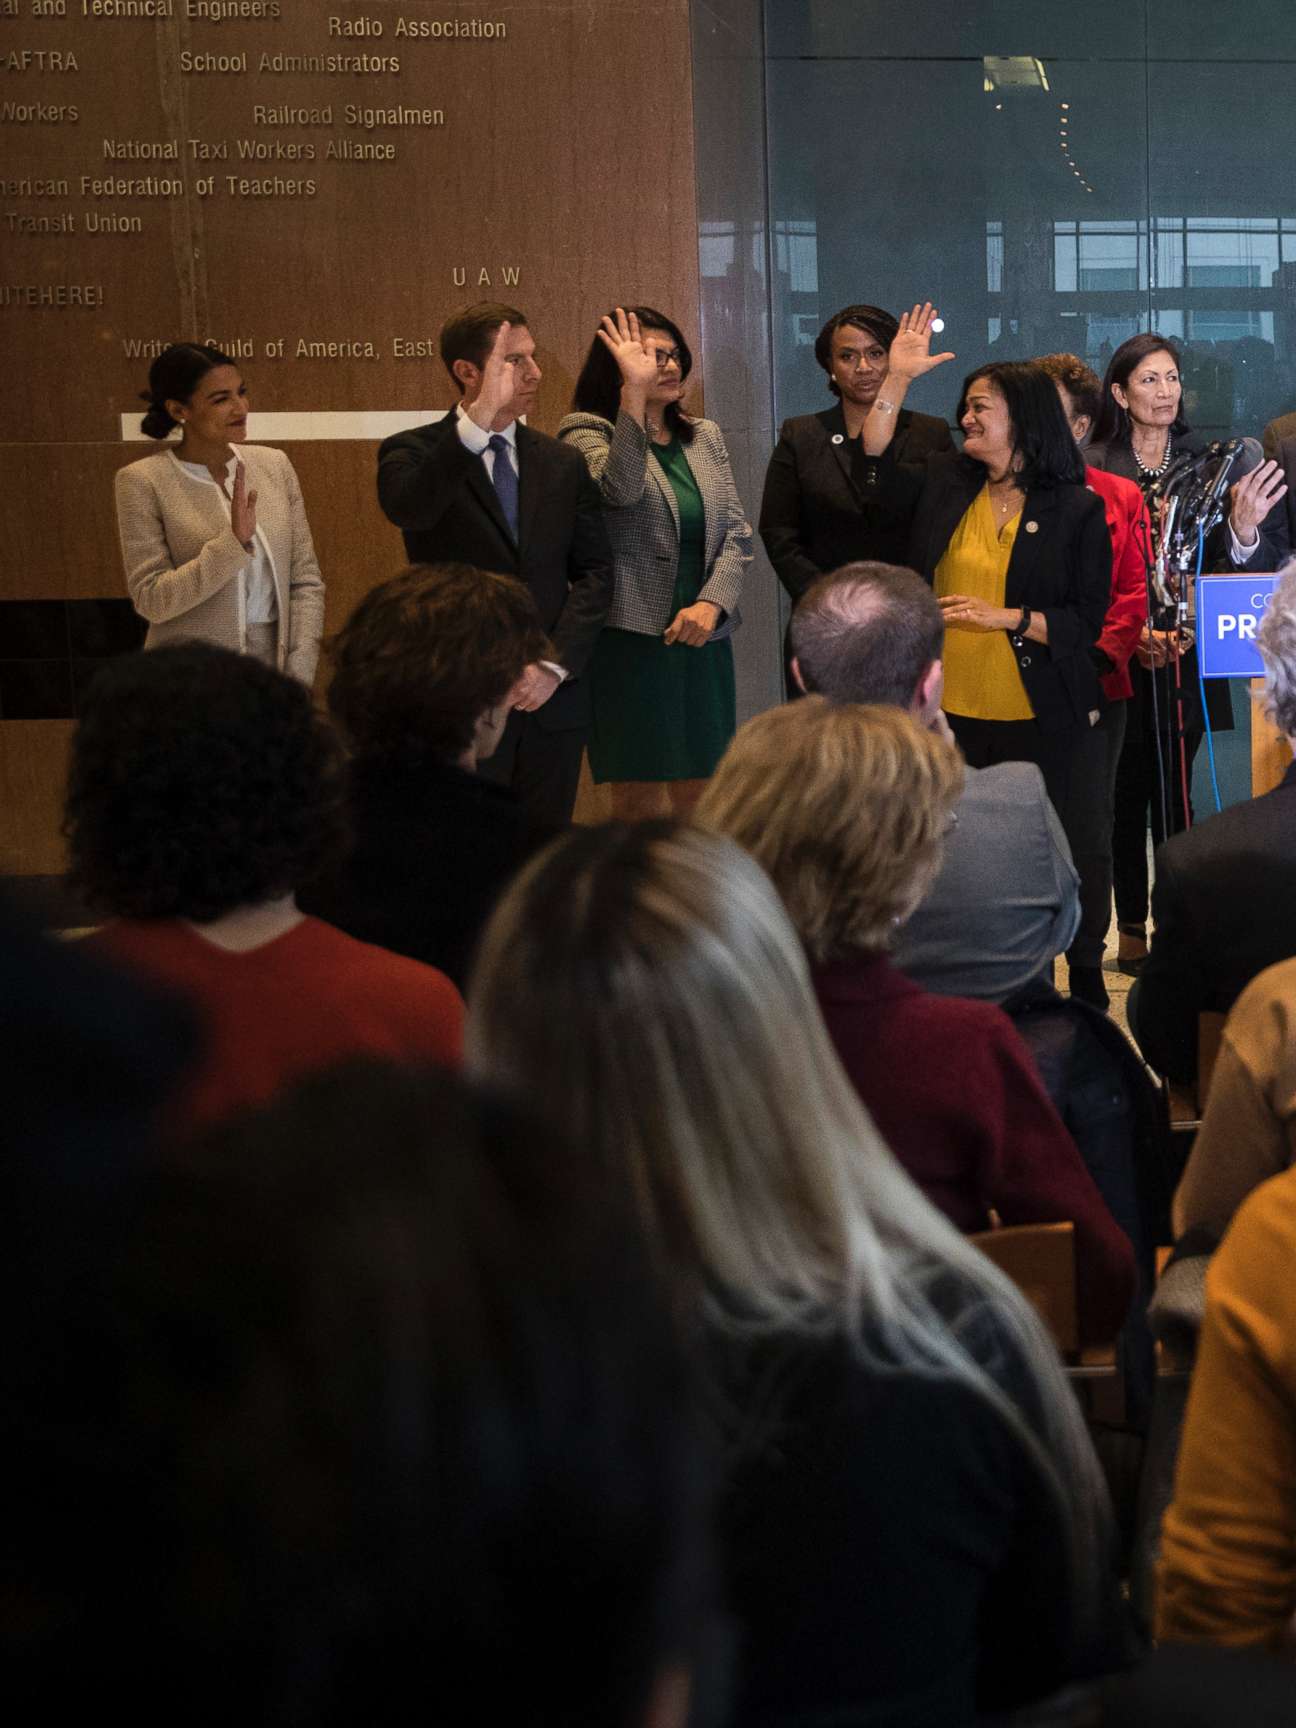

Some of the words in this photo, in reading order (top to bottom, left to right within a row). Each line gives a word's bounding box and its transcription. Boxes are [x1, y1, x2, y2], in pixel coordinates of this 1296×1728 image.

[32, 0, 66, 16] and
[82, 0, 174, 16] Technical
[186, 0, 281, 20] Engineers
[328, 16, 383, 37] Radio
[395, 17, 507, 38] Association
[180, 52, 247, 72] School
[259, 52, 400, 72] Administrators
[254, 105, 333, 125] Railroad
[345, 105, 444, 128] Signalmen
[103, 139, 178, 159] National
[188, 139, 228, 159] Taxi
[237, 140, 316, 160] Workers
[326, 140, 396, 160] Alliance
[81, 175, 183, 196] Federation
[196, 175, 215, 195] of
[226, 176, 317, 196] Teachers
[6, 212, 75, 233] Transit
[85, 213, 142, 233] Union
[0, 285, 104, 305] ITEHERE!
[265, 339, 285, 358] of
[296, 339, 380, 360] America,
[393, 338, 434, 357] East
